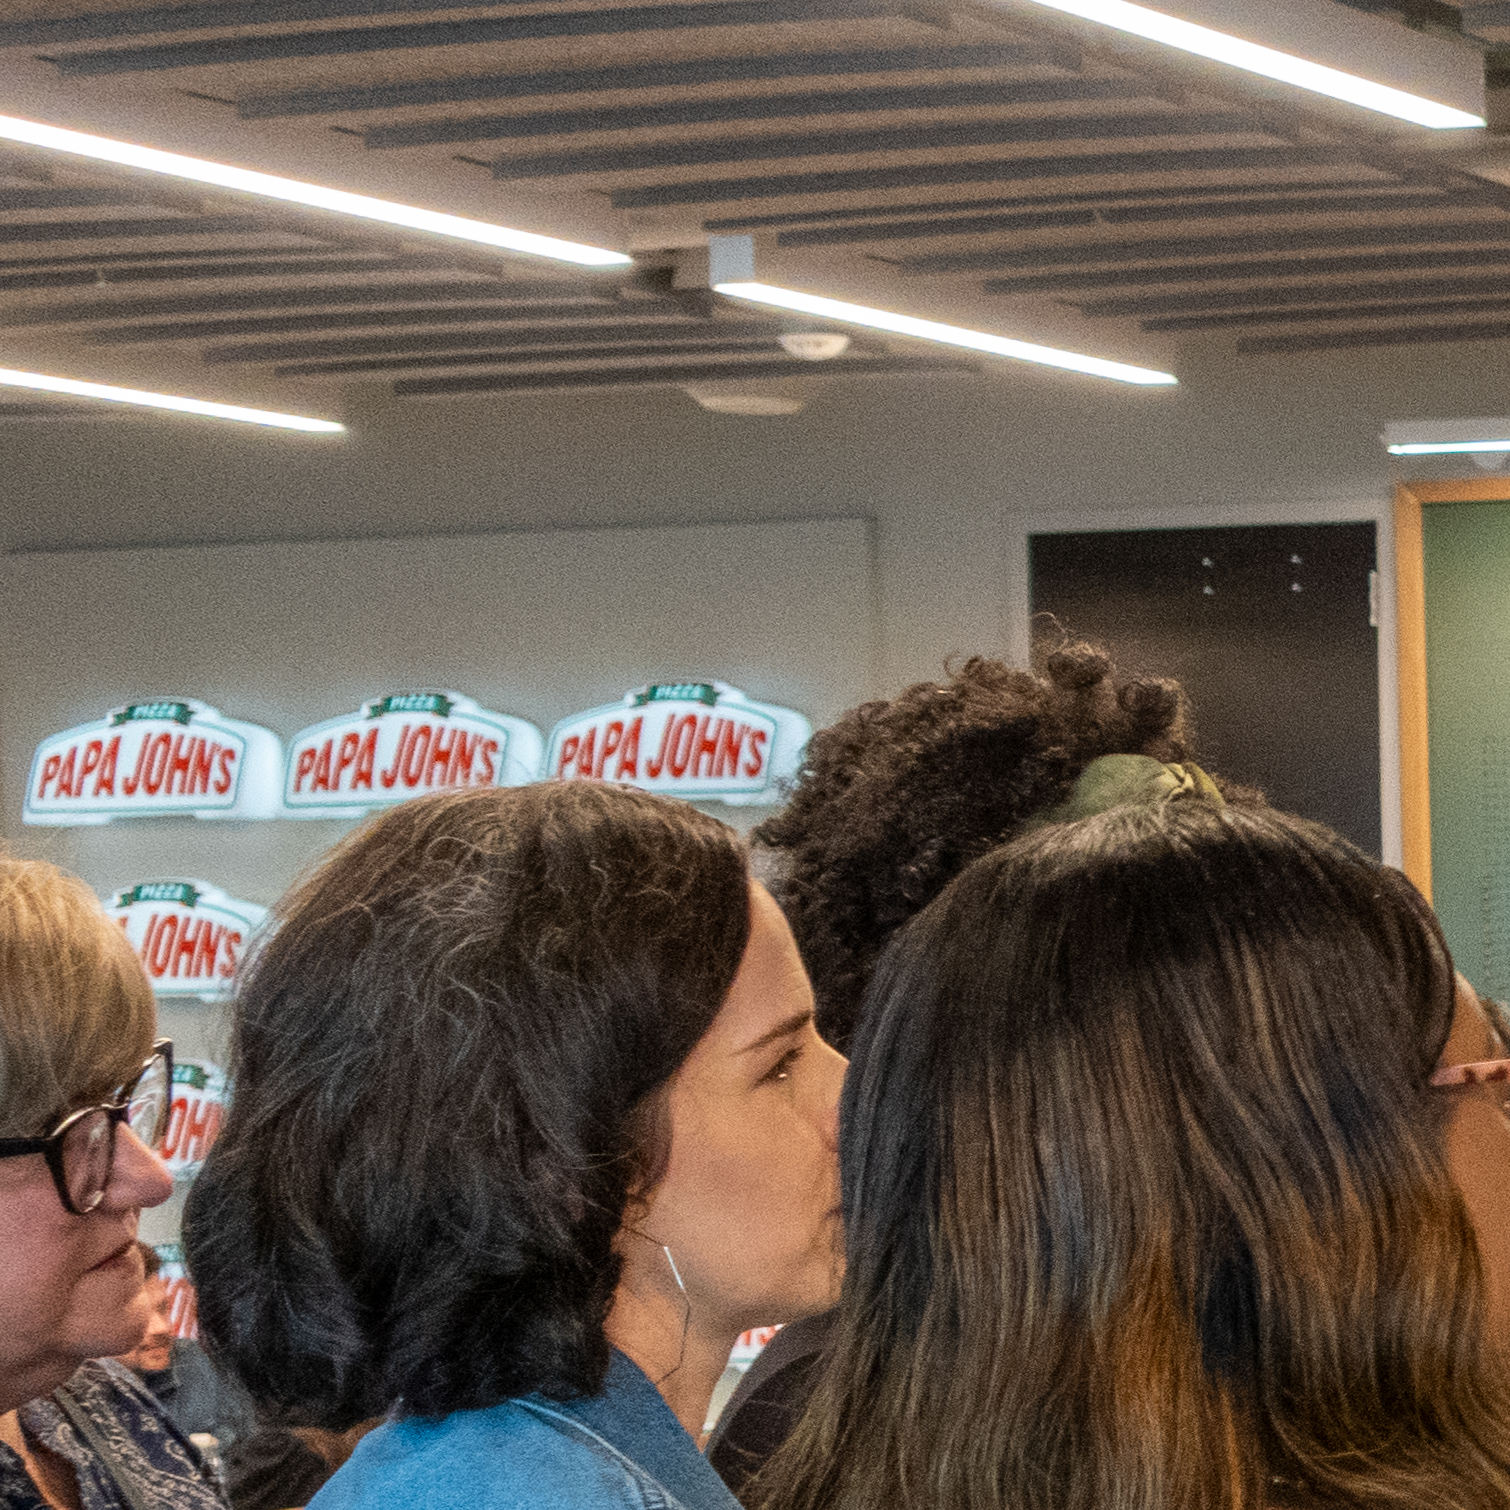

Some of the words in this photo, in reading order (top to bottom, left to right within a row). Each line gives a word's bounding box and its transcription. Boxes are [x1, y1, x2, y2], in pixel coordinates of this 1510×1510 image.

[37, 735, 122, 799] PAPA
[122, 732, 236, 796] JOHN'S
[293, 727, 380, 794] PAPA
[380, 724, 499, 789] JOHN'S
[557, 716, 643, 780] PAPA
[646, 713, 767, 779] JOHN'S
